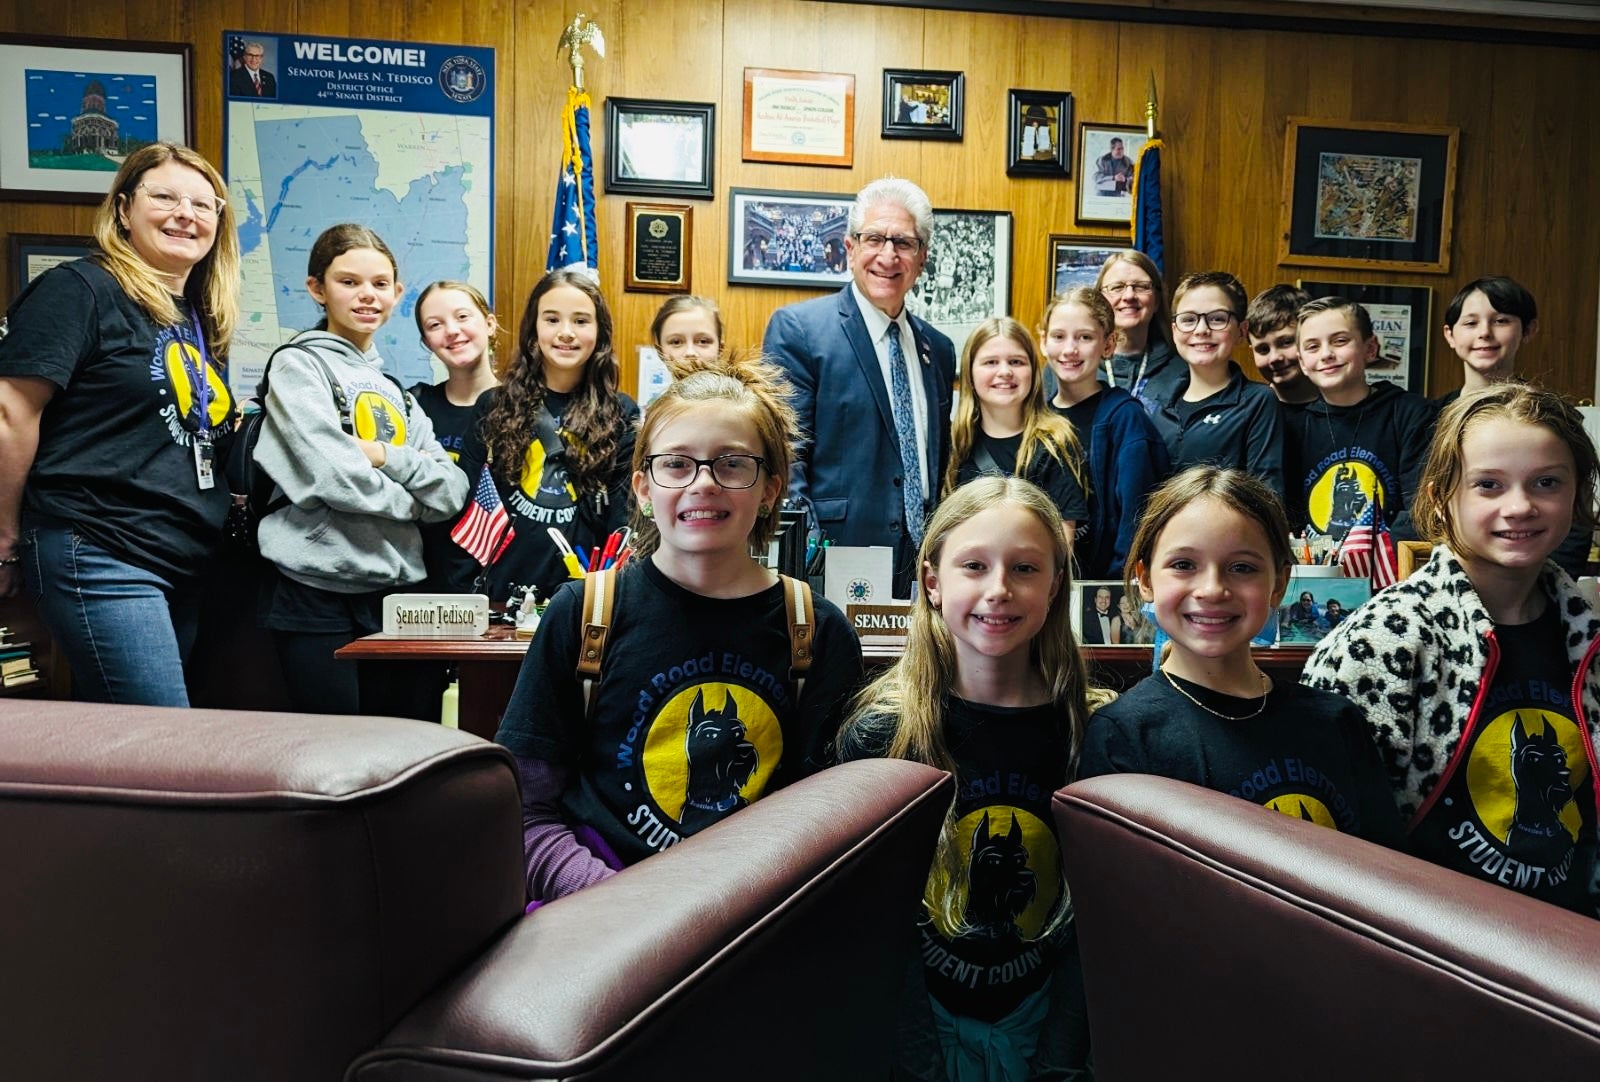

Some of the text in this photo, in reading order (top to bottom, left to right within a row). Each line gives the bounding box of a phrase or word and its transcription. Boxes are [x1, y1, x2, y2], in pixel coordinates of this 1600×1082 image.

[293, 41, 426, 67] WELCOME!
[287, 66, 433, 85] SENATOR JAMES N. TEDISCO
[326, 82, 364, 92] DISTRICT
[335, 92, 364, 101] SENATE
[366, 93, 403, 103] DISTRICT
[1372, 320, 1403, 332] GIAN
[396, 605, 474, 625] Senator Tedisco
[616, 689, 654, 770] Wood
[651, 651, 714, 695] Road
[1448, 820, 1546, 889] STUDENT
